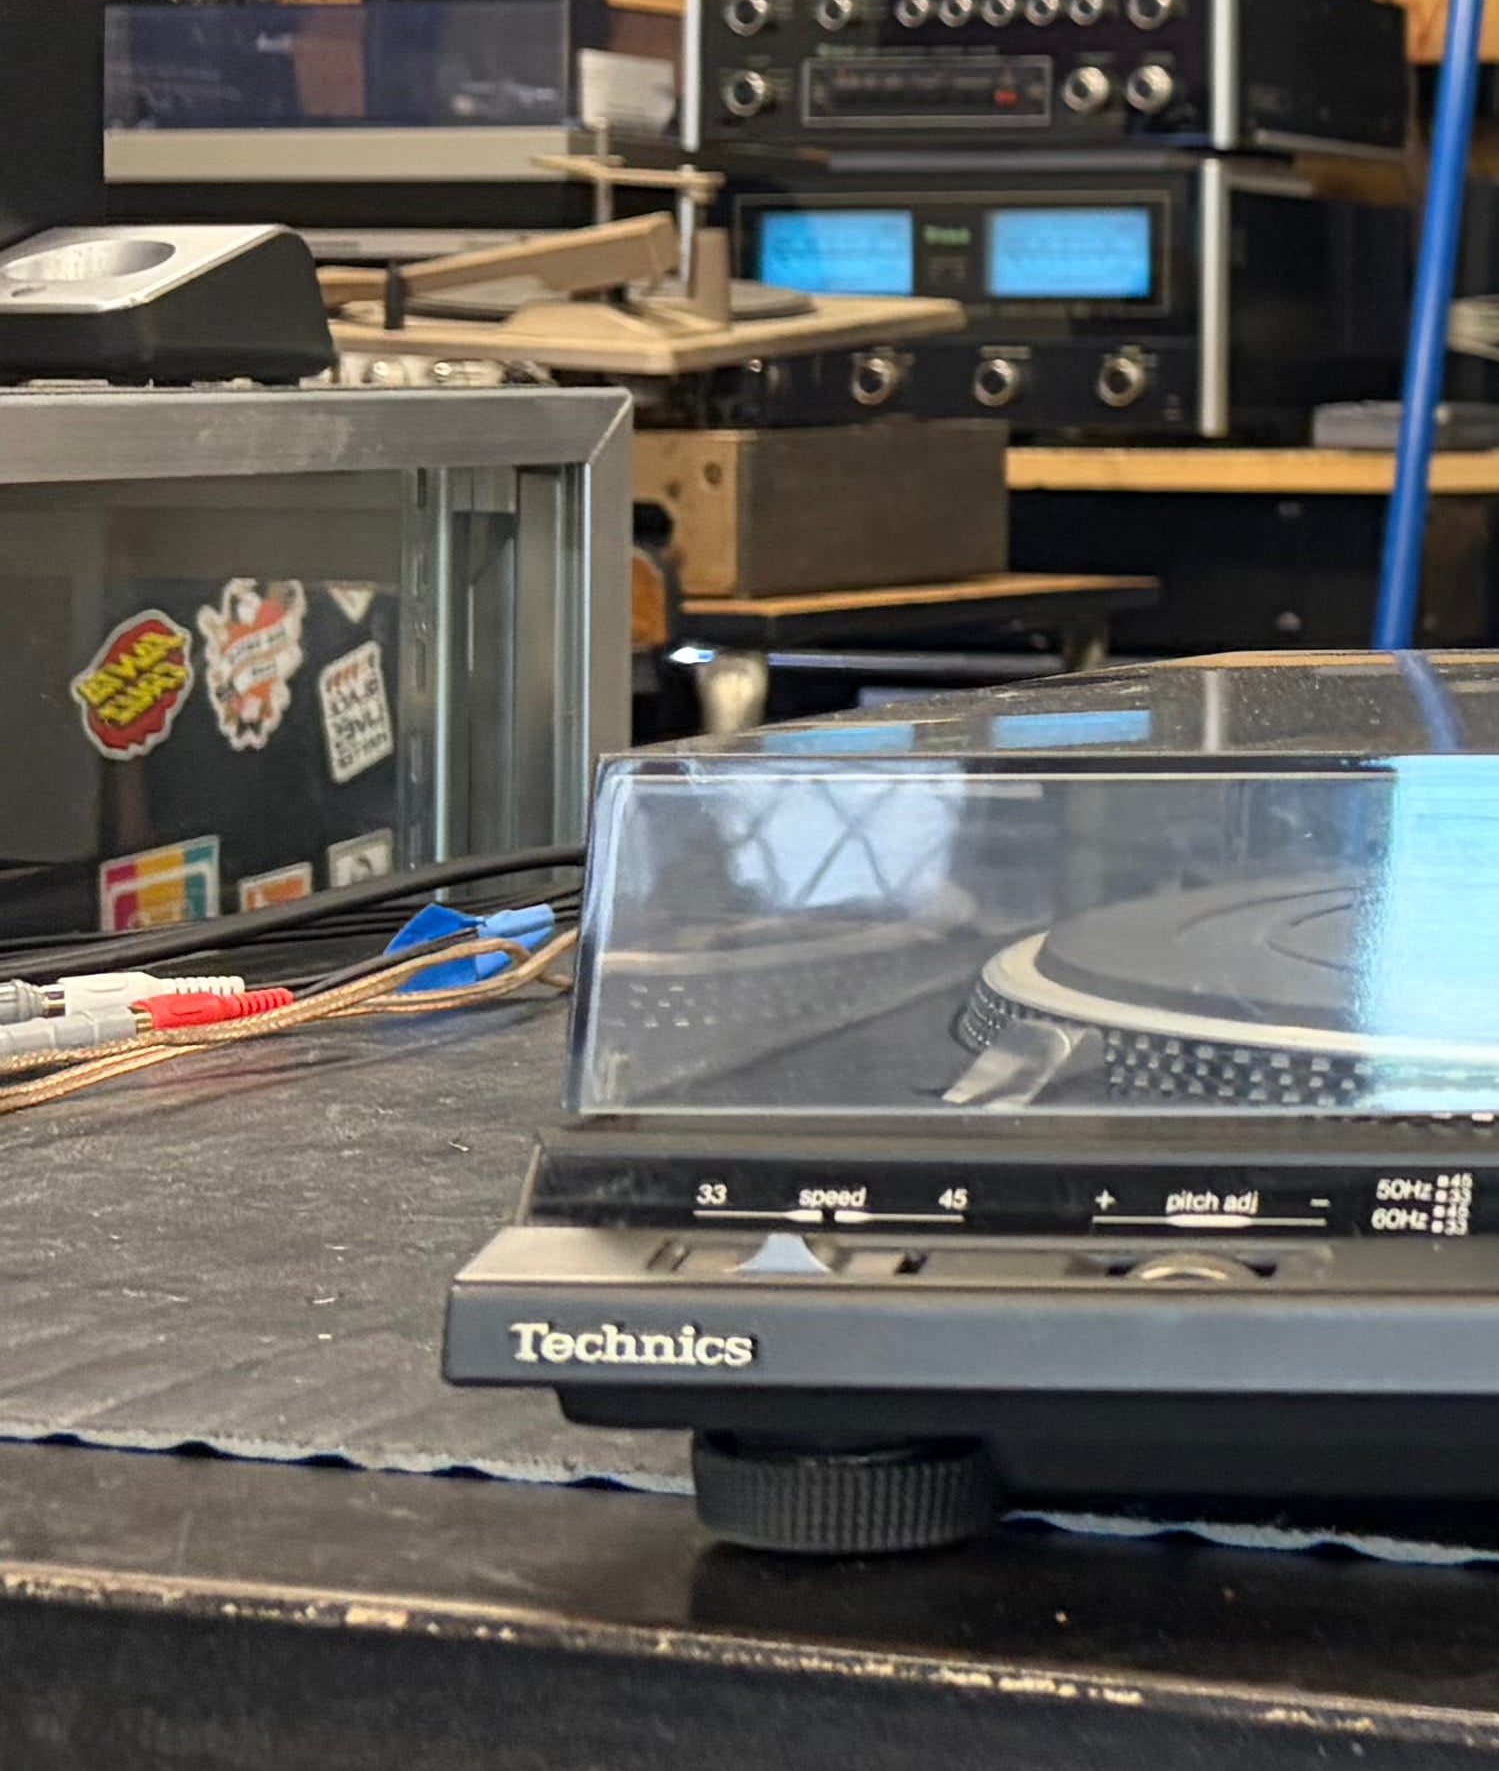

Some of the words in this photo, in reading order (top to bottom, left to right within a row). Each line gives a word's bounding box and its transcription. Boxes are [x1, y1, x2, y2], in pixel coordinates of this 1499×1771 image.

[697, 1183, 728, 1206] 33
[799, 1186, 867, 1208] speed
[938, 1188, 968, 1210] 45
[1165, 1189, 1219, 1214] pitch
[1223, 1189, 1259, 1215] adj
[1376, 1178, 1432, 1201] 50Hz
[1371, 1207, 1429, 1231] 60Hz
[509, 1322, 753, 1367] Technics
